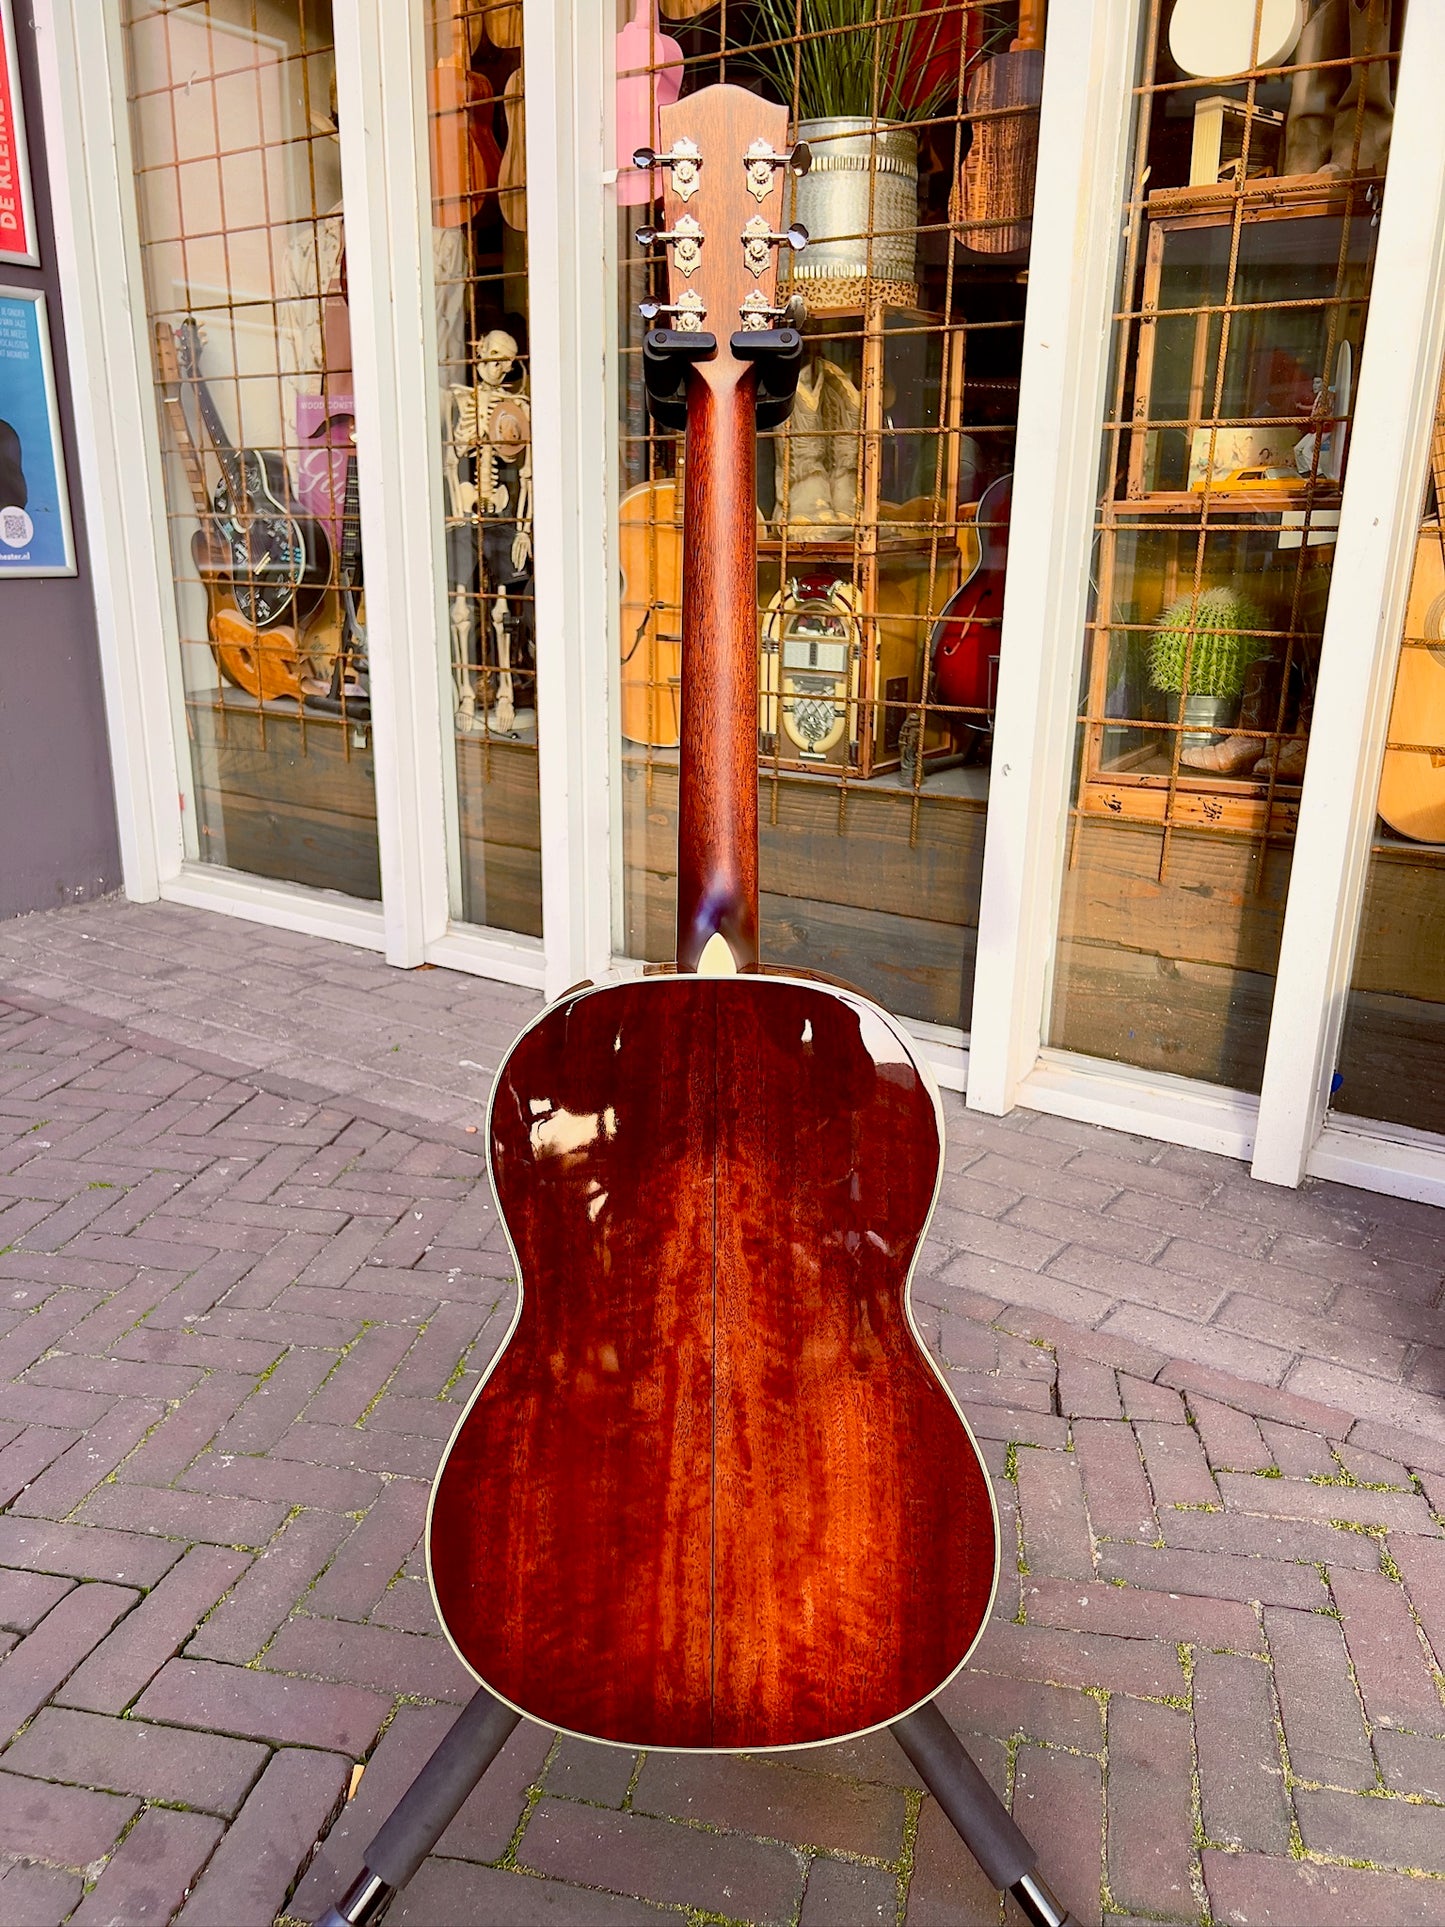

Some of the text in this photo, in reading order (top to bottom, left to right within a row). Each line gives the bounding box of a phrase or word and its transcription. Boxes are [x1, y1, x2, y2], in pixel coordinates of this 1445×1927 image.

[0, 197, 18, 229] DE
[15, 320, 26, 329] JAZZ
[7, 350, 30, 359] MOMENT
